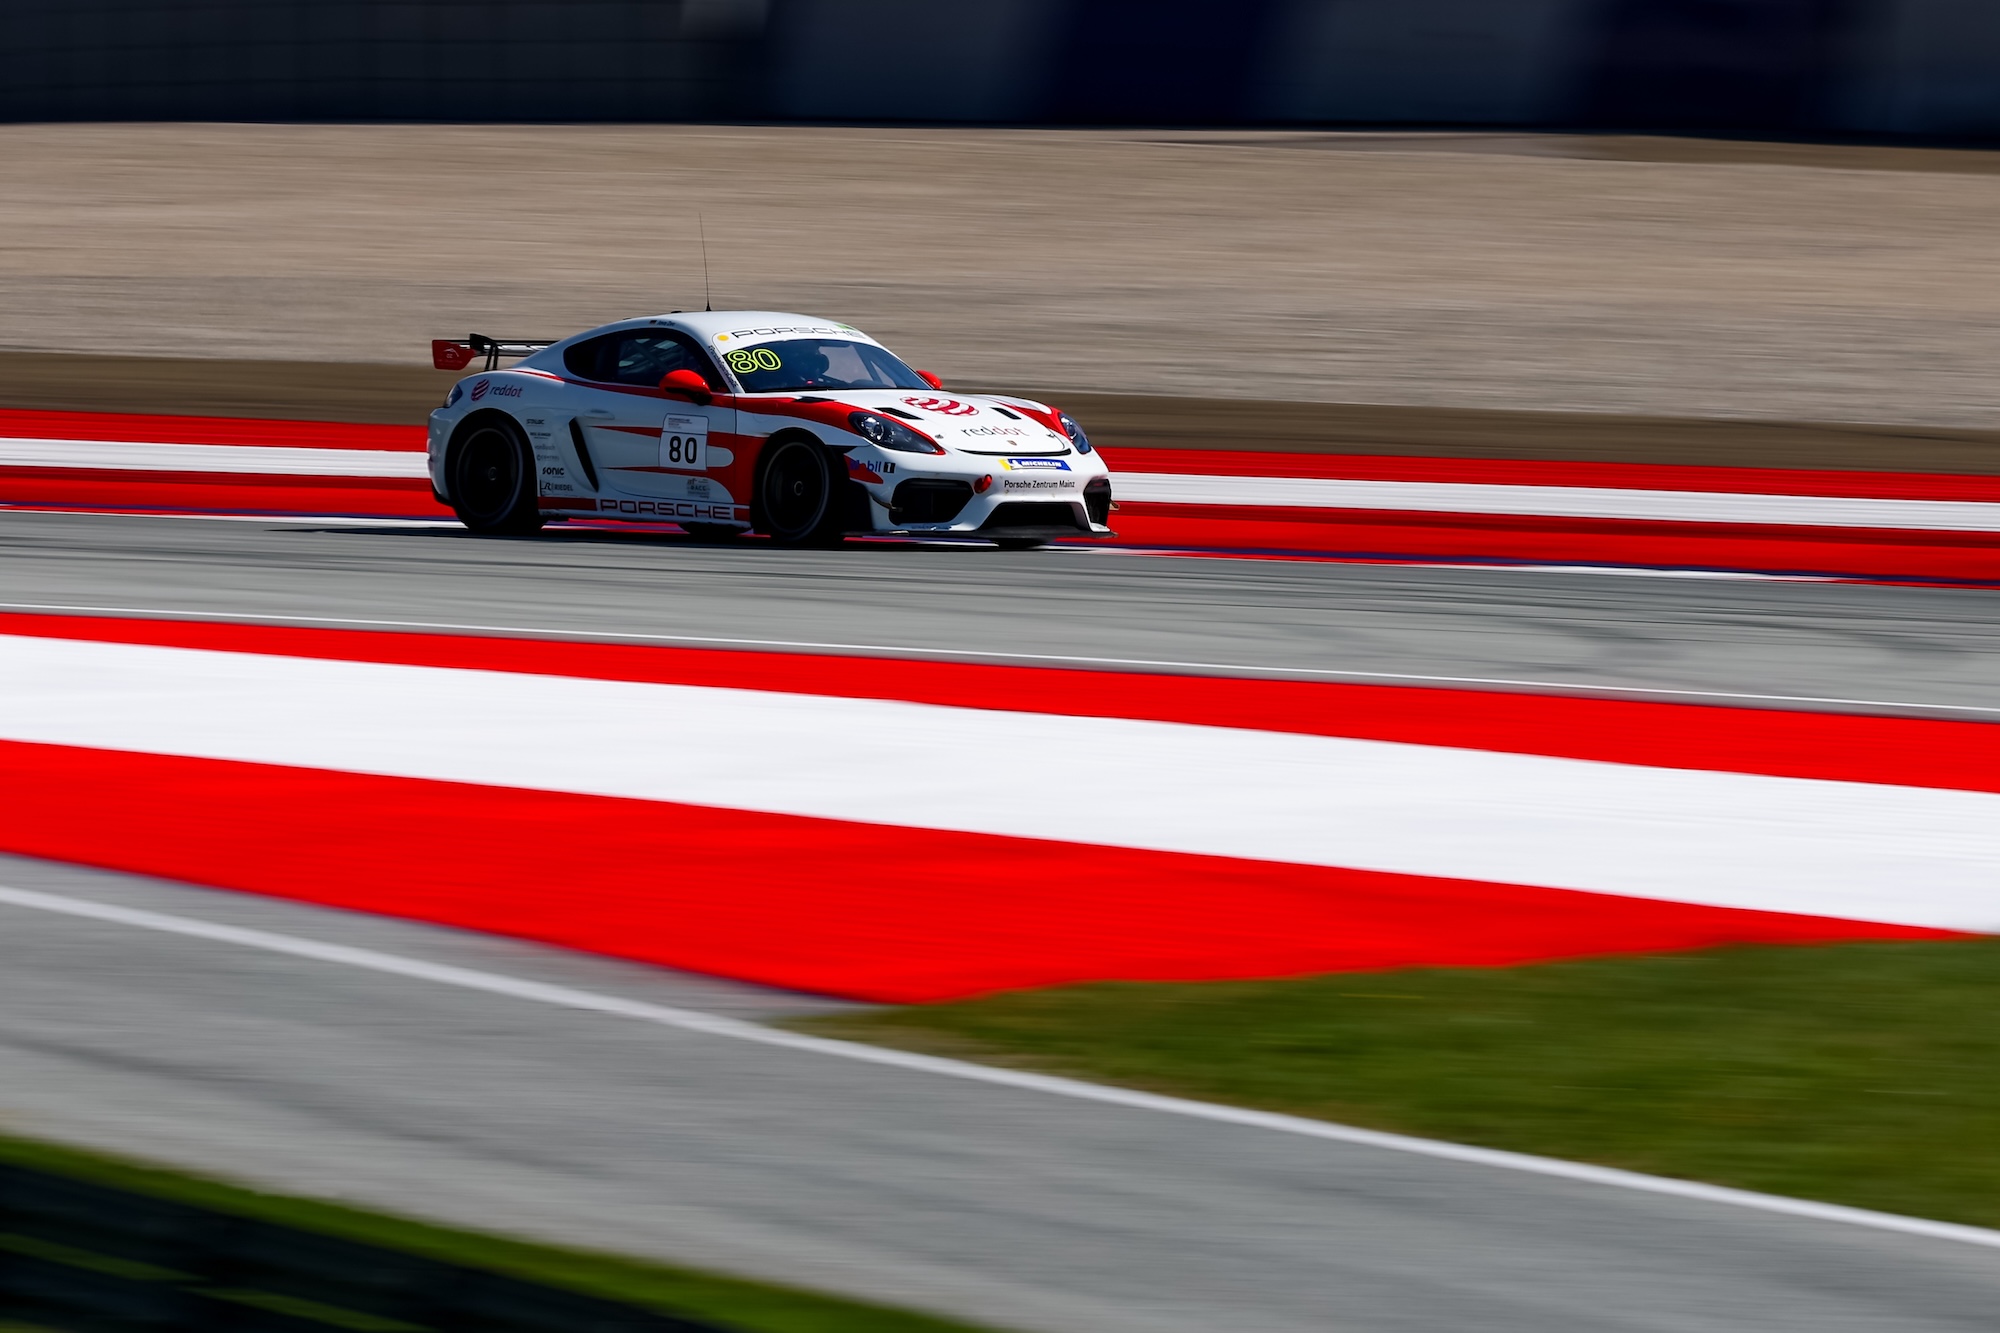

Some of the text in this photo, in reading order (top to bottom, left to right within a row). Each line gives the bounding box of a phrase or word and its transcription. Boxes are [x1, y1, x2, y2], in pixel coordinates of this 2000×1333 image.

[730, 327, 865, 339] PORSCHE
[727, 348, 782, 374] 80
[489, 384, 523, 398] reddot
[960, 425, 1030, 437] reddot
[669, 435, 697, 464] 80
[1004, 480, 1075, 488] Porsche Zentrum Mainz
[600, 499, 731, 520] PORSCHE
